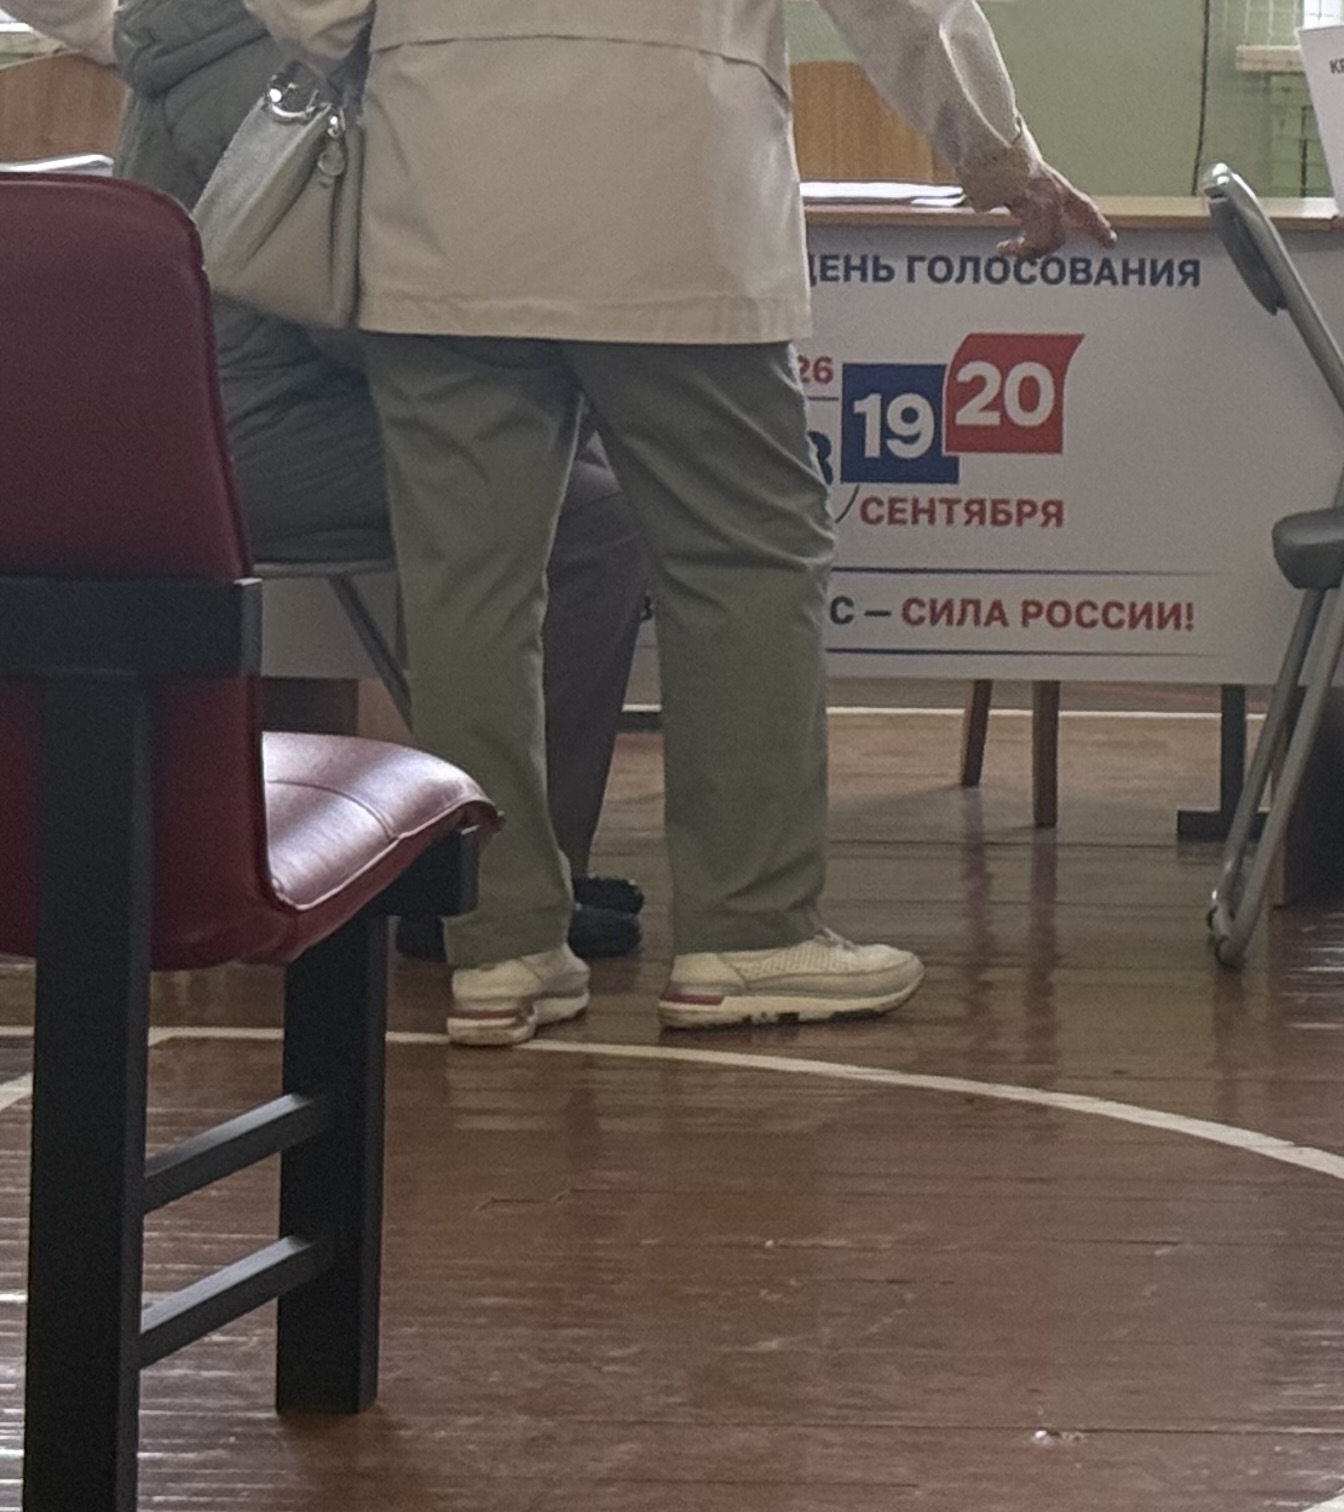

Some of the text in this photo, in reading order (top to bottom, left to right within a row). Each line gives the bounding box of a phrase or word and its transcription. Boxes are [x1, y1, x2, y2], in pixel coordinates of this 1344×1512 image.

[907, 254, 1201, 287] ГОЛОСОВАНИЯ
[799, 355, 834, 385] 26
[955, 360, 1056, 428] 20
[853, 391, 935, 459] 19
[860, 496, 1065, 528] СЕНТЯБРЯ
[901, 597, 1010, 628] СИЛА
[1021, 599, 1196, 632] РОССИИ!
